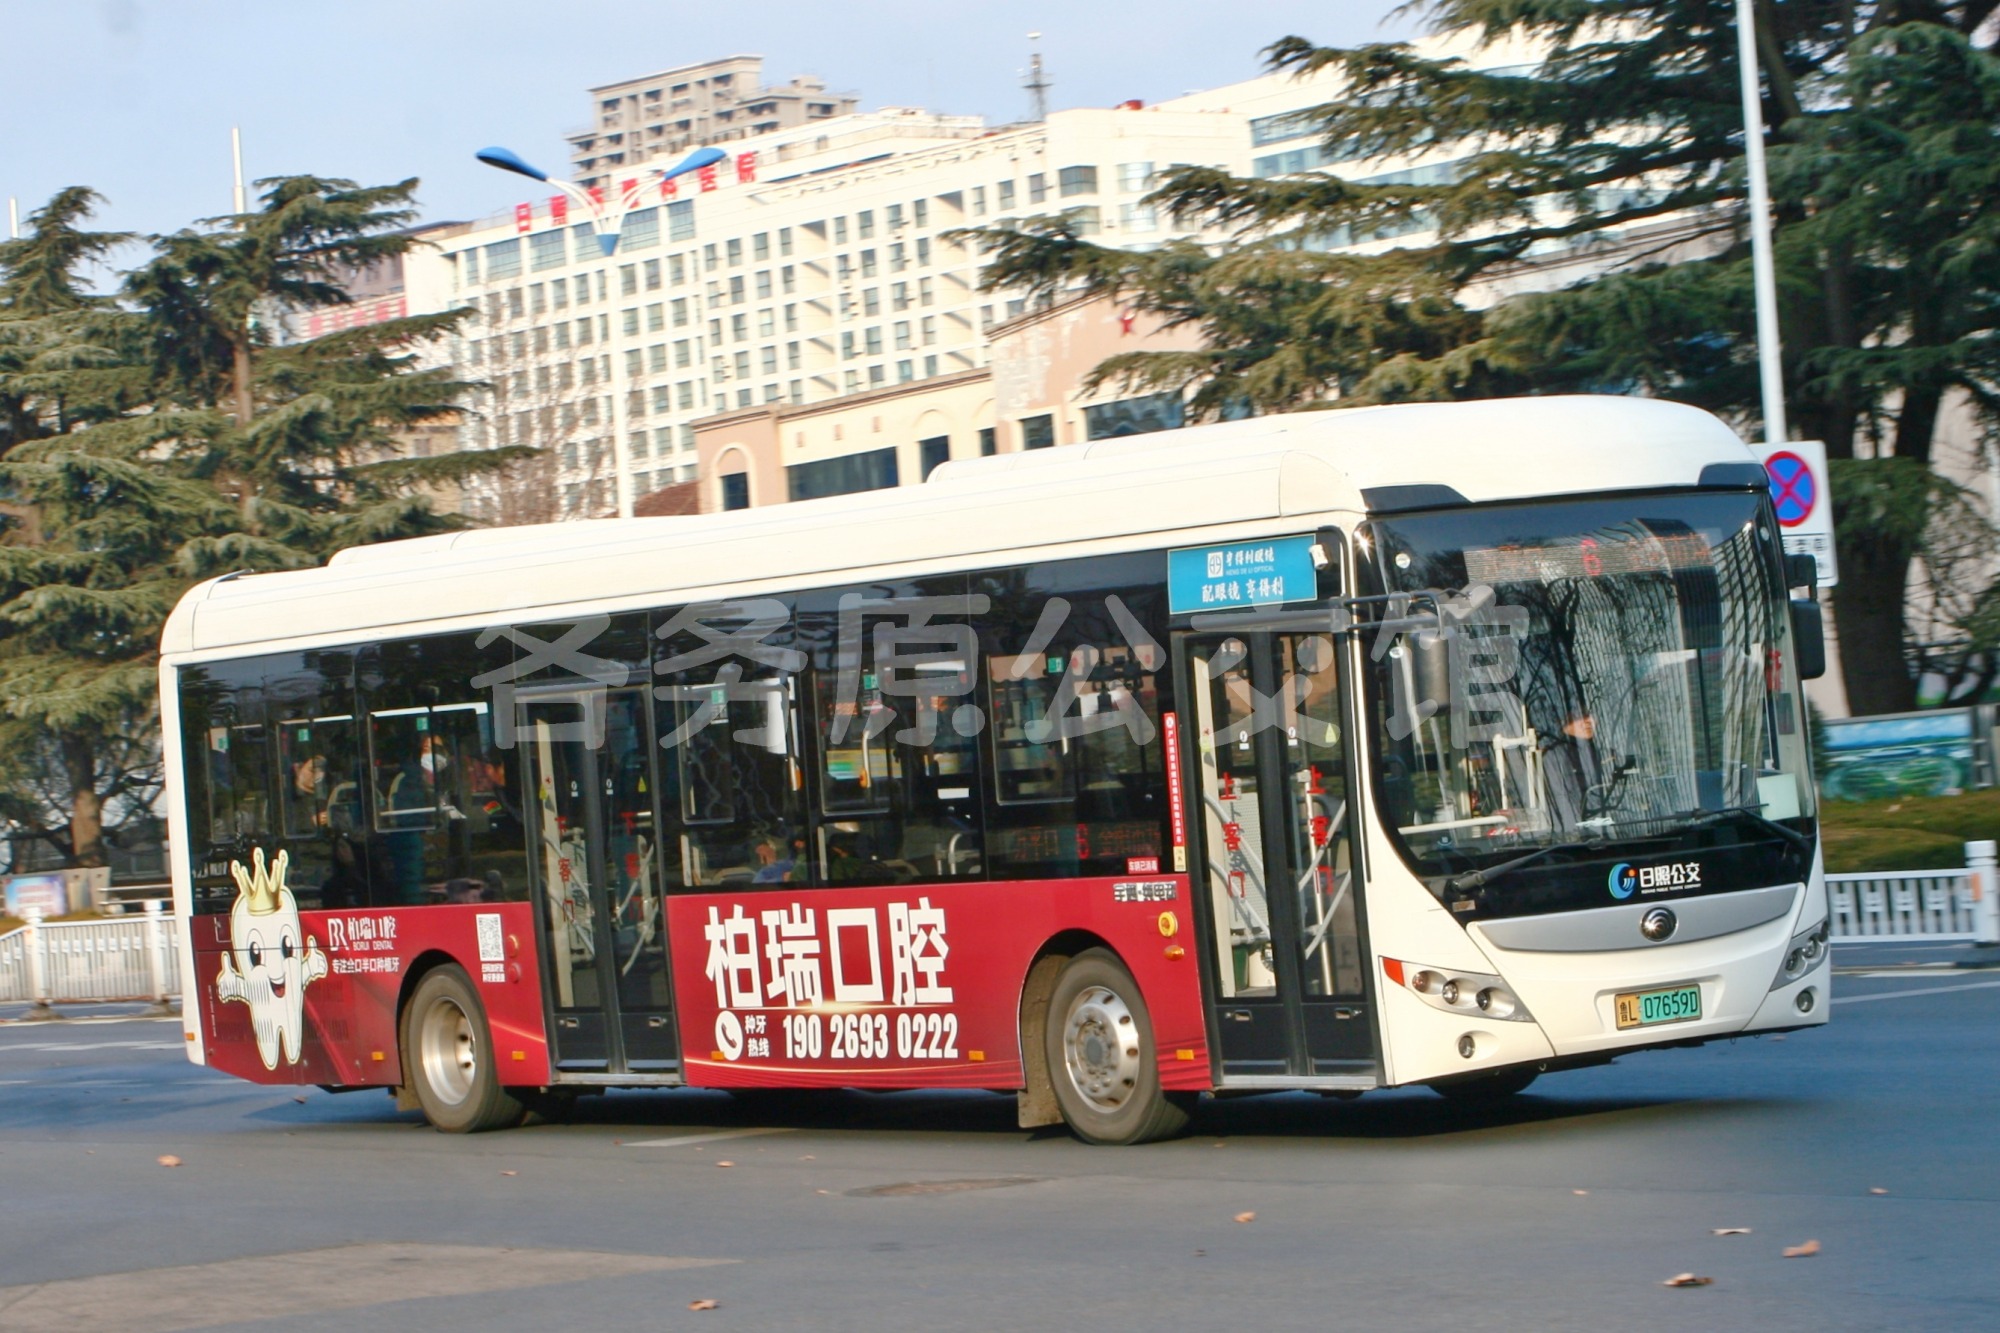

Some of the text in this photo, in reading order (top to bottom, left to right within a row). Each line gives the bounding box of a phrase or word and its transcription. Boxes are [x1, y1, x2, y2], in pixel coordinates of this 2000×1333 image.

[1580, 537, 1603, 576] 6
[1202, 581, 1240, 603] 配眼镜
[1219, 772, 1245, 898] 上客门
[1307, 765, 1334, 895] 上客门
[1639, 862, 1701, 888] 日照公交
[347, 916, 397, 940] 柏瑞口腔
[353, 940, 394, 951] BORUI DENTAL
[704, 897, 953, 1008] 柏瑞口腔
[745, 1015, 767, 1034] 种牙
[783, 1013, 958, 1059] 190 2693 0222
[748, 1038, 770, 1058] 热线
